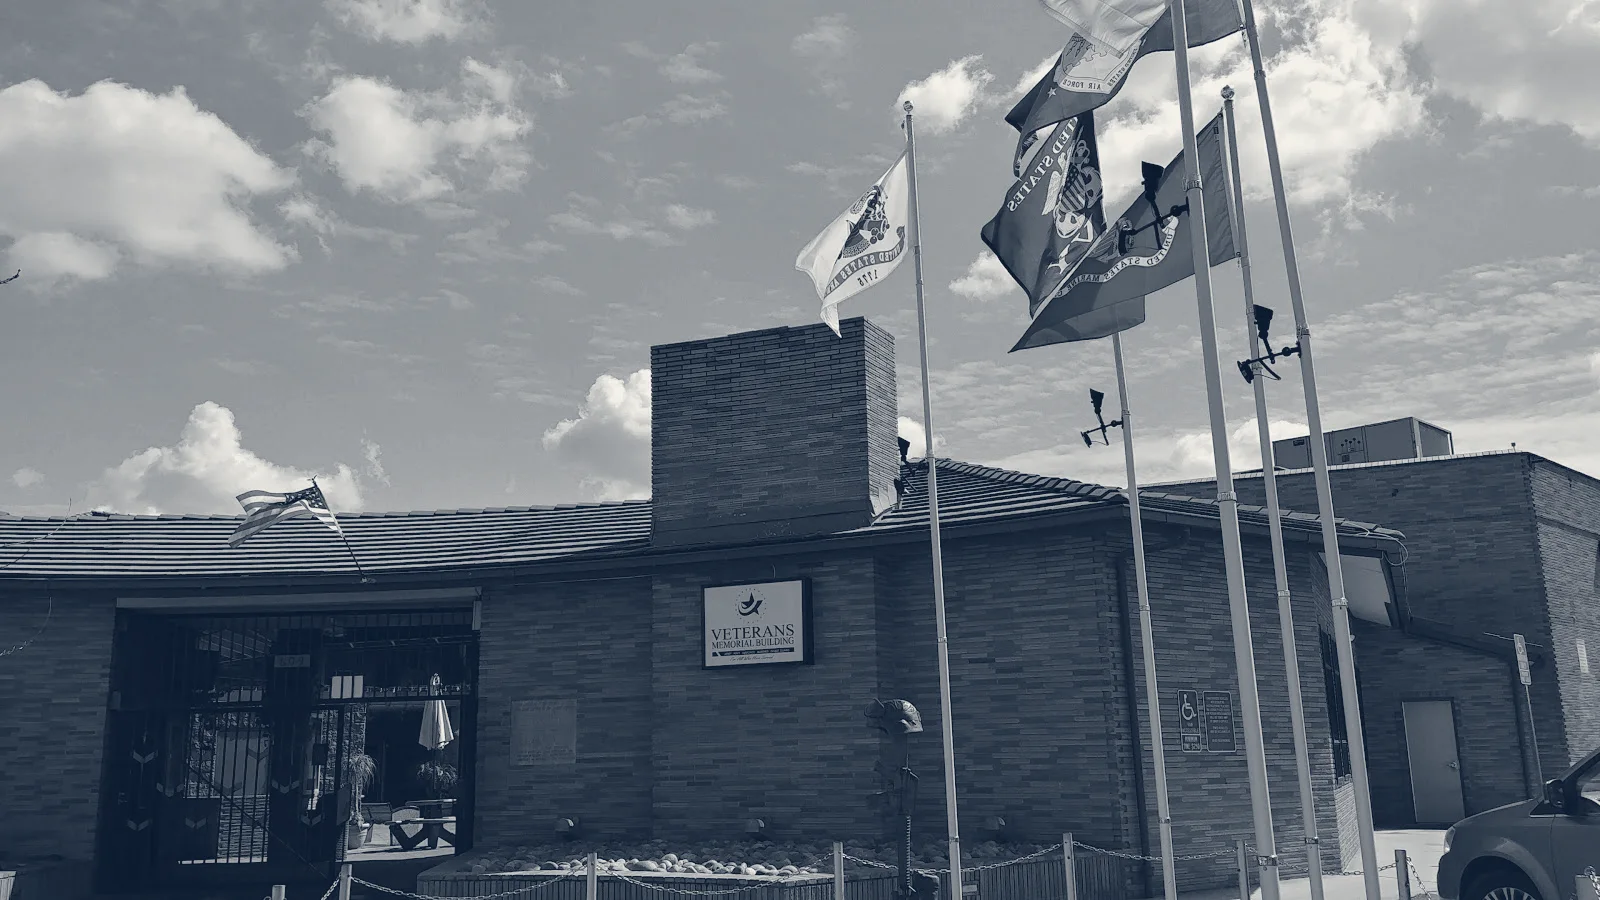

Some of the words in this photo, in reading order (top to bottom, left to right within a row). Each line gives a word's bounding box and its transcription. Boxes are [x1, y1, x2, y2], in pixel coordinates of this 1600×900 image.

[711, 624, 795, 641] VETERANS
[711, 640, 755, 649] MEMORIAL
[755, 637, 795, 647] BUILDING
